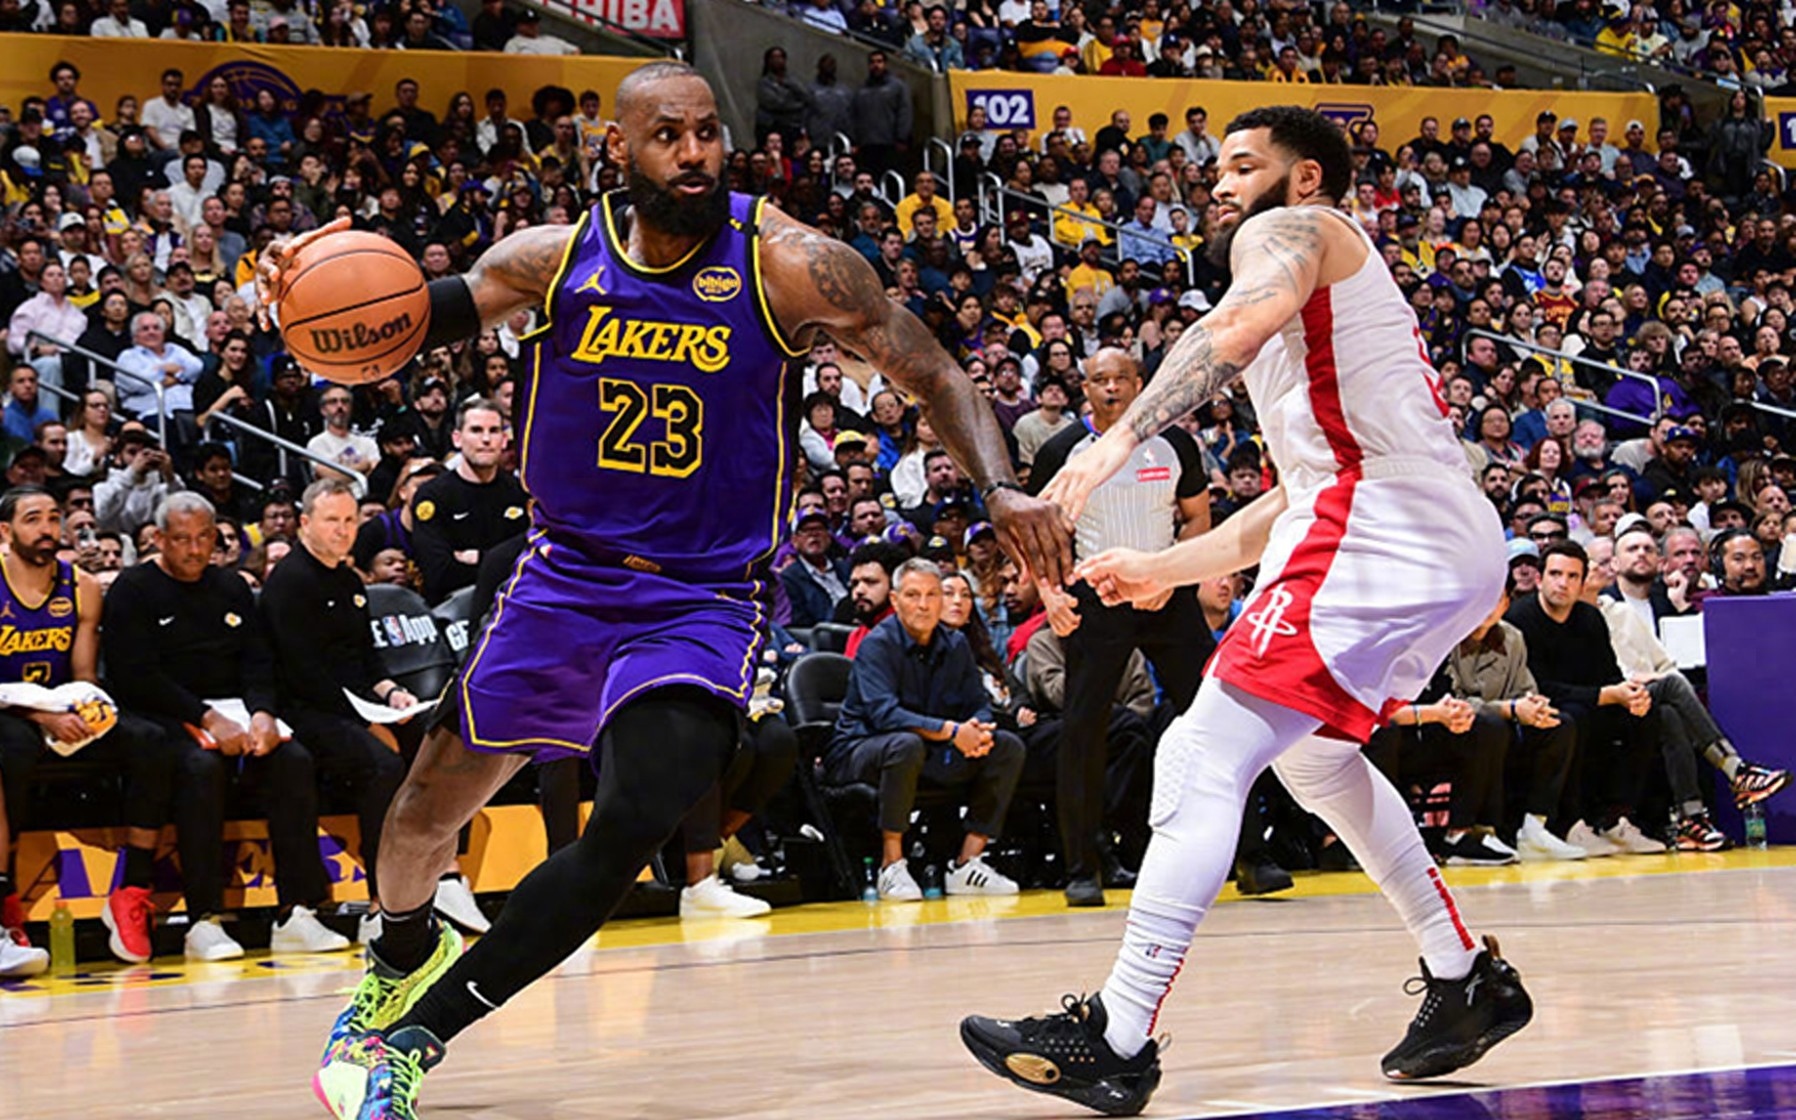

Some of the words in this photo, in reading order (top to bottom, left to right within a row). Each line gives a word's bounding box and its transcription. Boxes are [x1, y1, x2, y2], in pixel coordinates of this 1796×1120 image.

[310, 312, 412, 354] Wilson
[571, 305, 732, 373] LAKERS
[597, 377, 703, 478] 23
[0, 625, 72, 655] LAKERS
[399, 614, 438, 645] App
